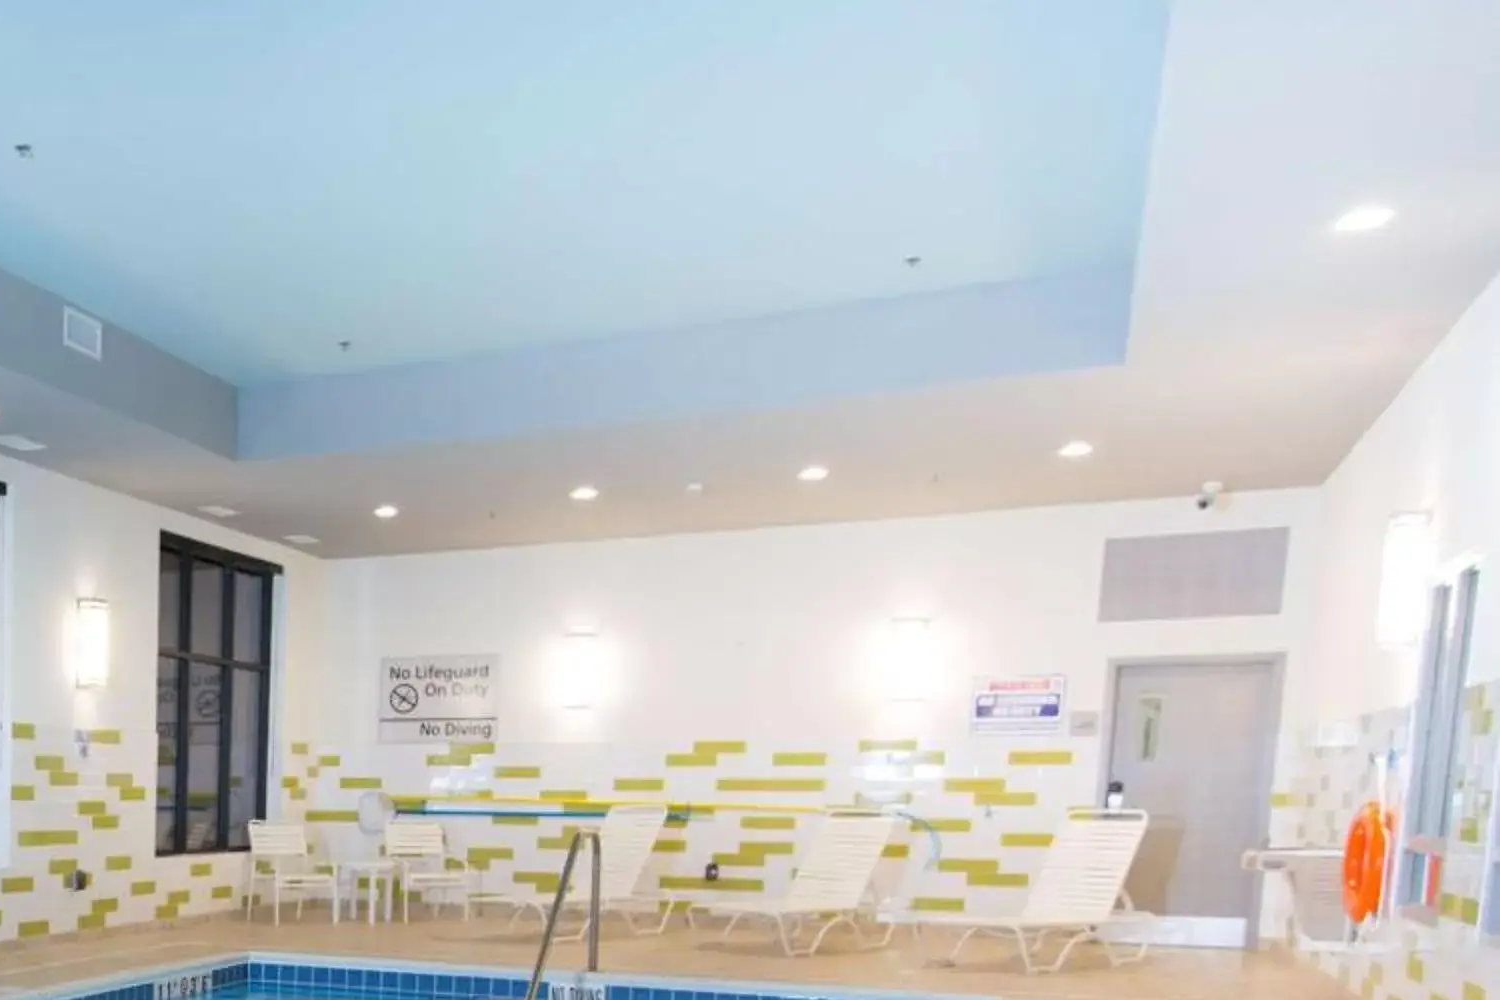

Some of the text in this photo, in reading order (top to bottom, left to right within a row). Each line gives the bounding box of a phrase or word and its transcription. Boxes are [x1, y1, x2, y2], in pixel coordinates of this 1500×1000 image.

[389, 664, 490, 682] No Lifeguard
[425, 682, 488, 697] On Duty
[419, 722, 492, 739] No Diving
